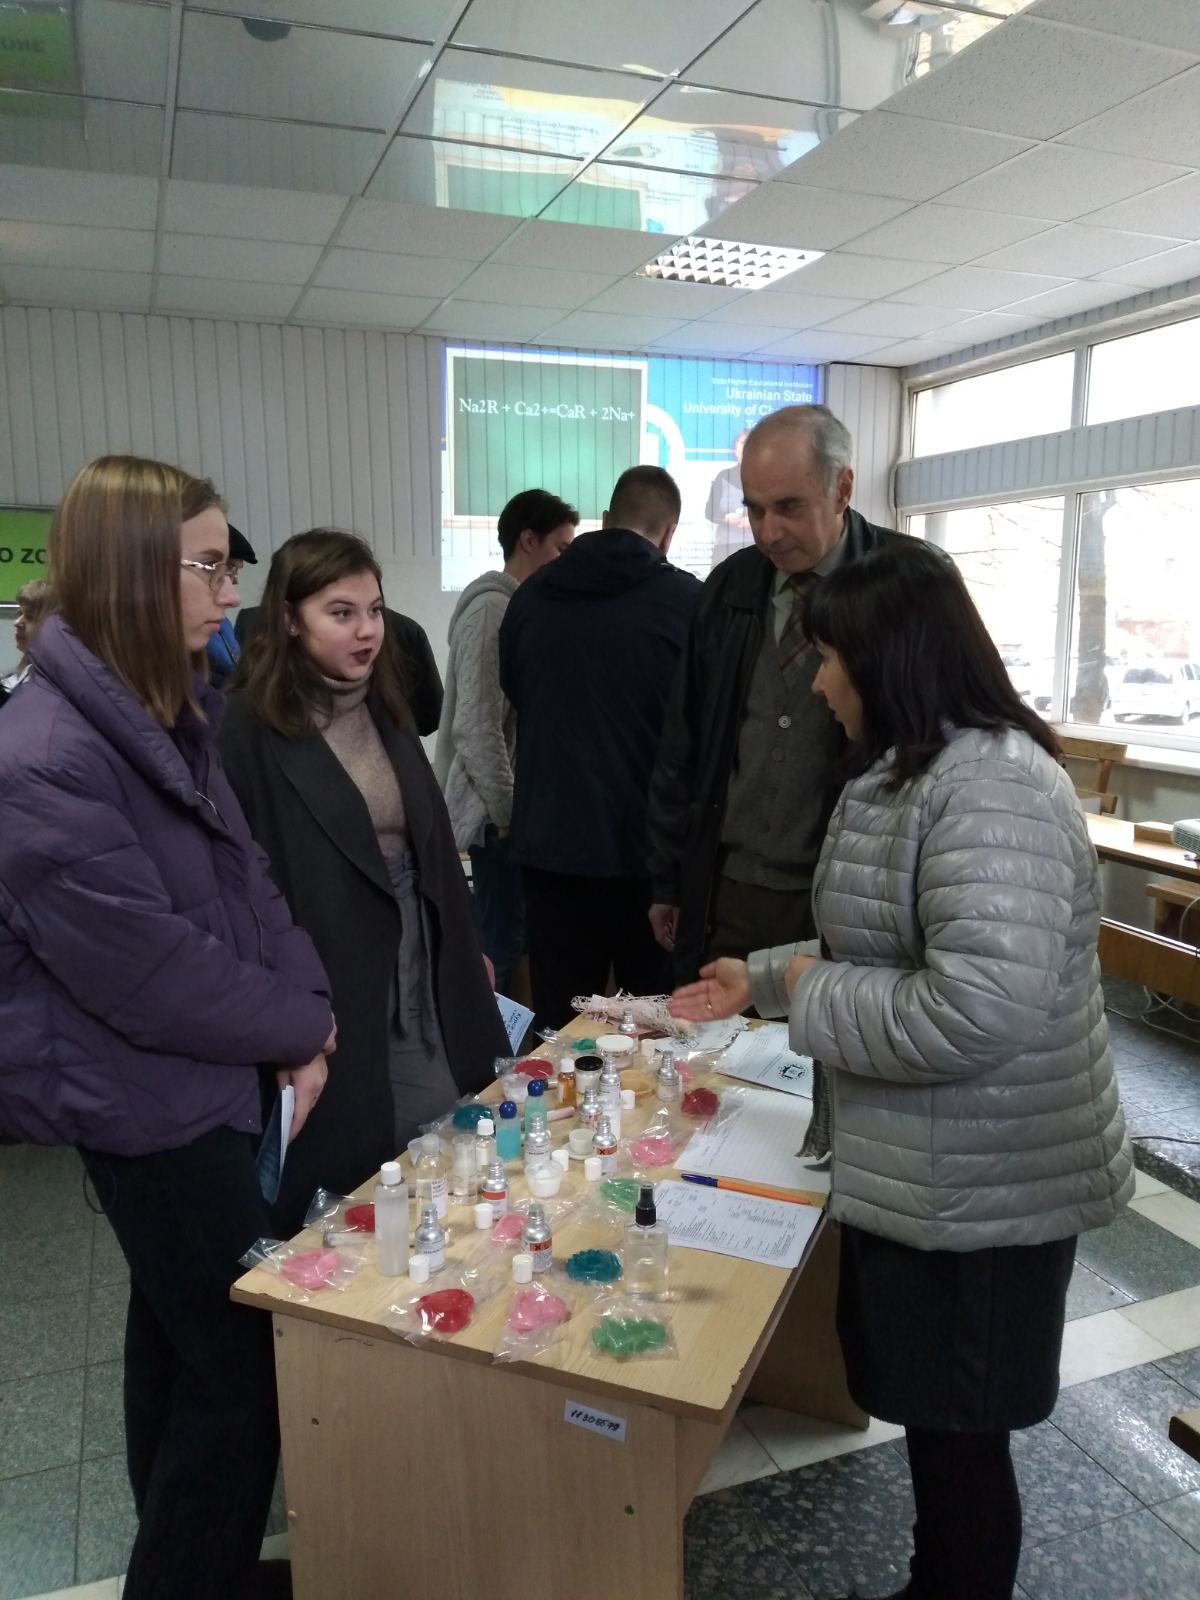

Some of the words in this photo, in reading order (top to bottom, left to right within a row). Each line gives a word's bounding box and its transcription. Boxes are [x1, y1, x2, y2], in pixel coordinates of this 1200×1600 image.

[726, 387, 780, 401] Ukrainian
[783, 389, 813, 402] State
[459, 397, 499, 414] Na2R
[601, 405, 636, 422] 2Na+
[682, 401, 741, 417] University
[744, 404, 758, 416] of
